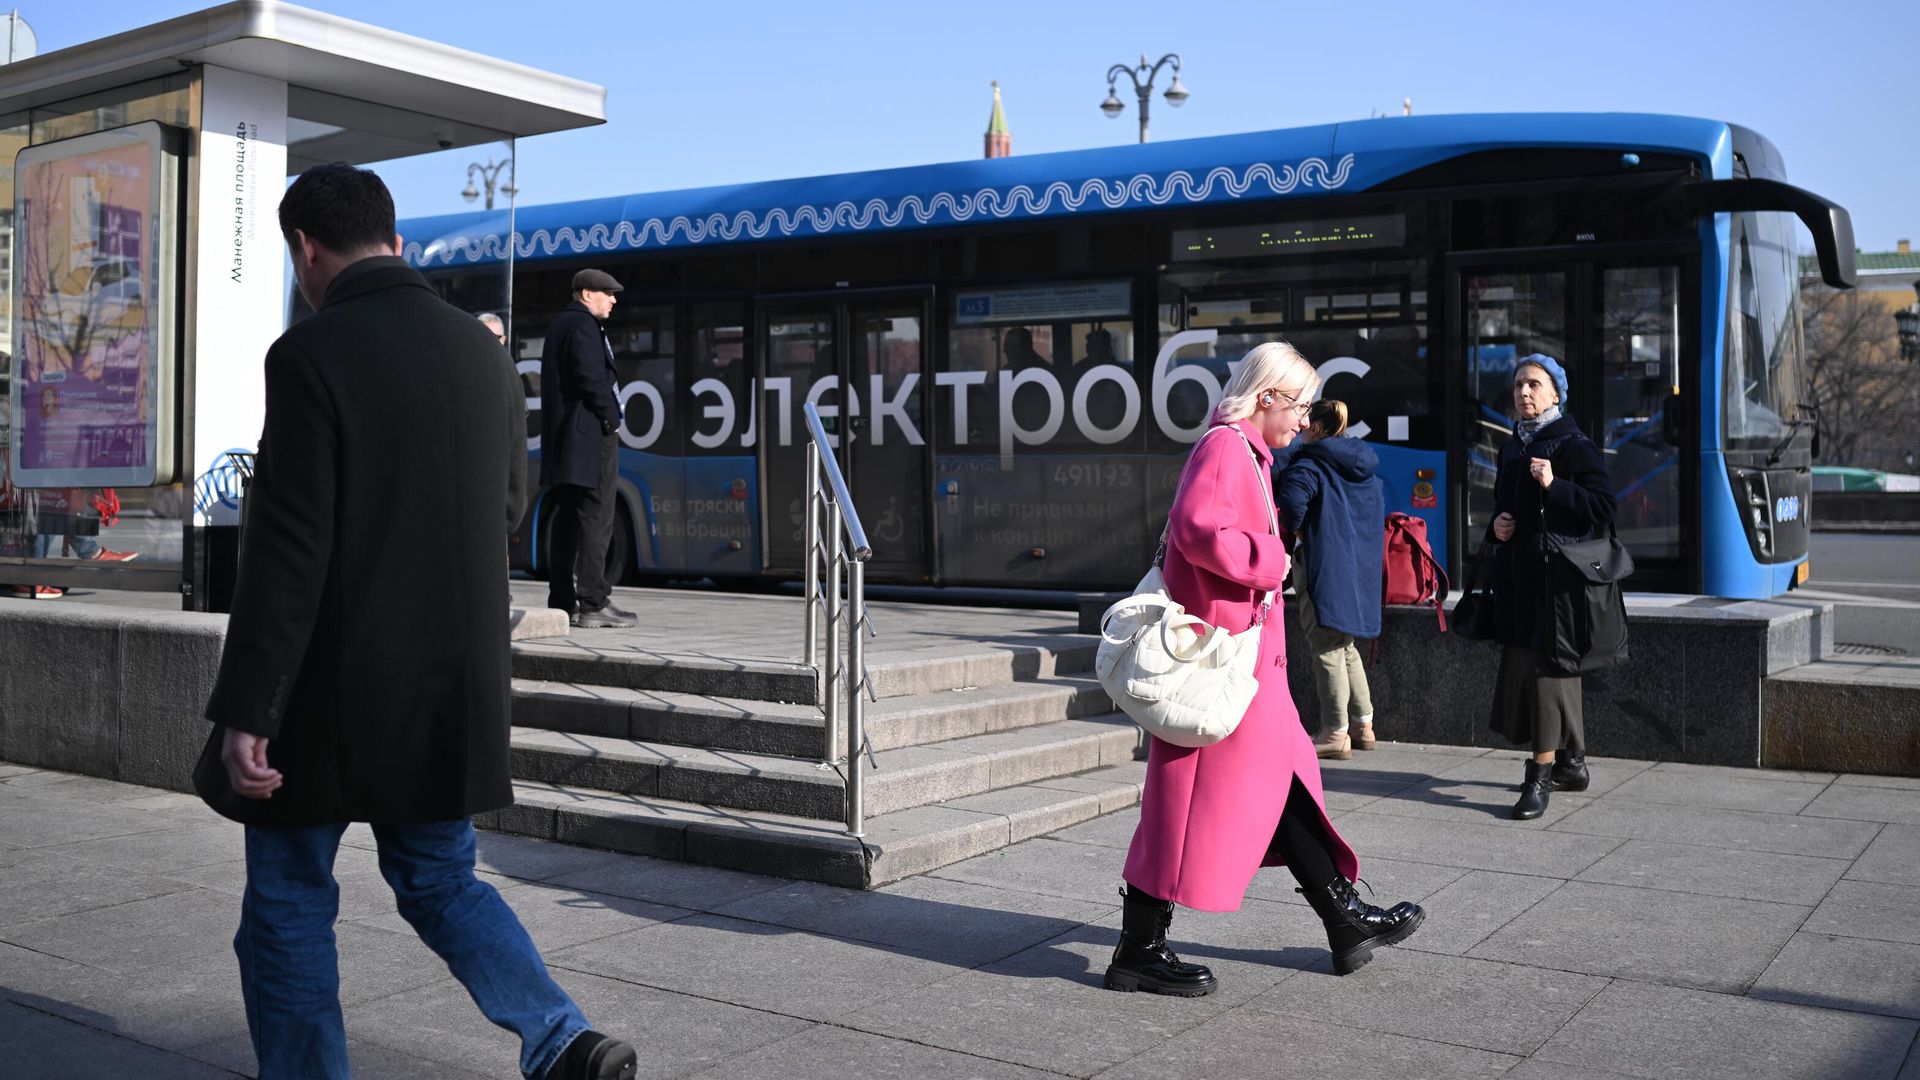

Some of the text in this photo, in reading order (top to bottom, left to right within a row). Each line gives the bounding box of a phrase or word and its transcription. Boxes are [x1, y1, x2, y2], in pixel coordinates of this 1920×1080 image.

[231, 121, 247, 283] Манежная площадь
[689, 329, 1409, 470] электробс.
[1053, 464, 1133, 488] 491193
[651, 495, 745, 517] Без тряски
[973, 498, 1112, 521] Не привязан
[651, 519, 752, 541] и вибраций
[975, 530, 985, 543] к
